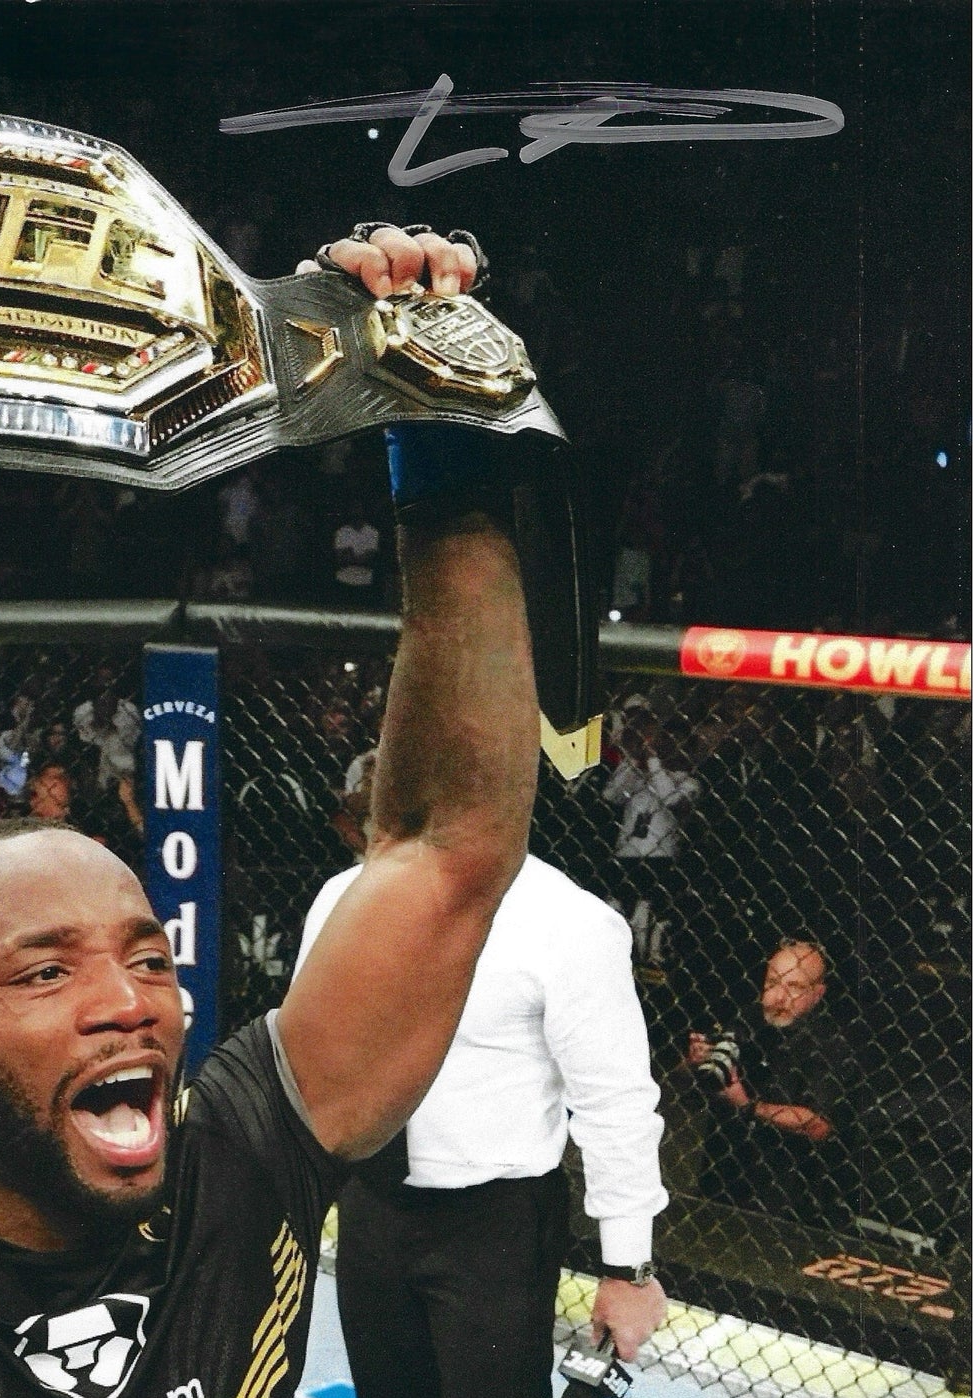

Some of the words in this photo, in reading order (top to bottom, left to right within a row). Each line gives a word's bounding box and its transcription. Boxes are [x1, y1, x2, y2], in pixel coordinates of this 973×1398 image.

[426, 310, 477, 341] WORLD
[770, 635, 970, 689] HOWL
[143, 701, 215, 723] CERVEZA
[563, 1350, 607, 1378] UFC
[603, 1368, 629, 1398] UFC
